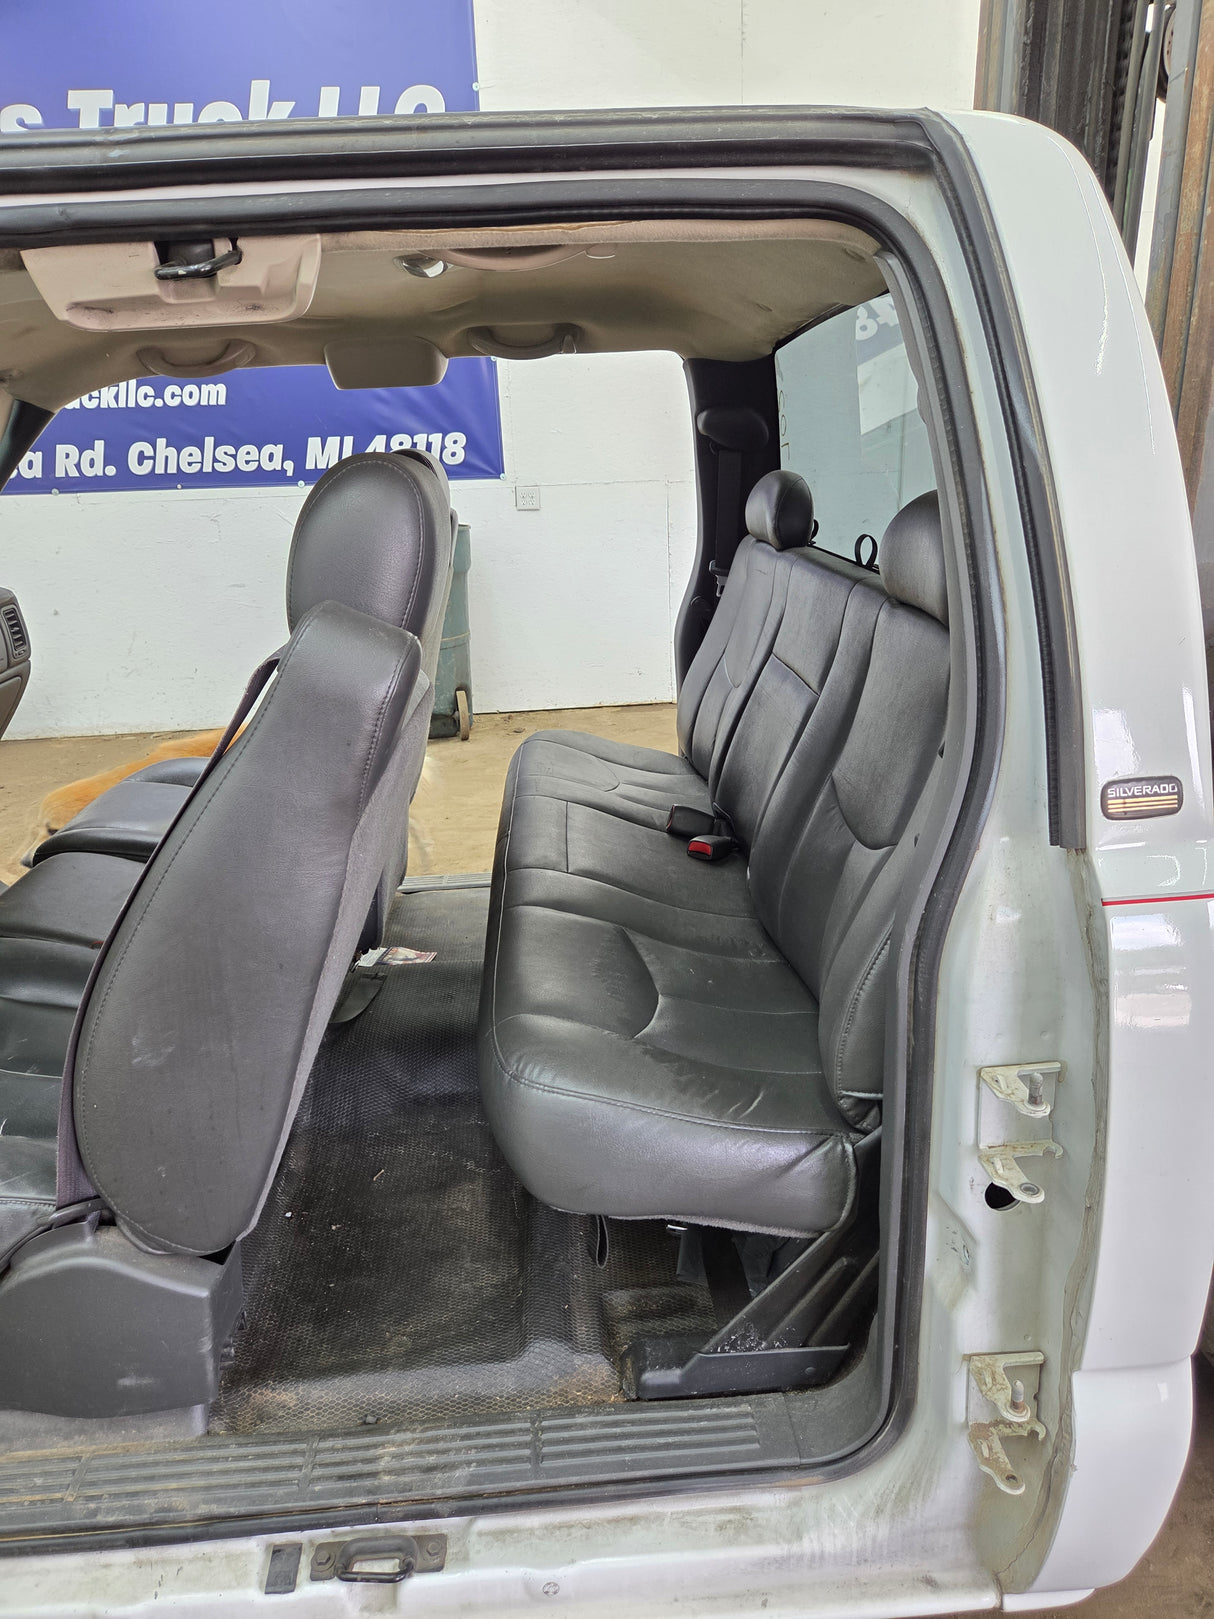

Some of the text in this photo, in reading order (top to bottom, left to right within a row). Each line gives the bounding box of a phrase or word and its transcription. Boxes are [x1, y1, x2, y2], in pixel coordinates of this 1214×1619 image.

[9, 451, 43, 479] a
[55, 440, 117, 478] Rd.
[128, 436, 294, 477] Chelsea,
[305, 436, 354, 470] MI
[1107, 783, 1178, 798] SILVERADO
